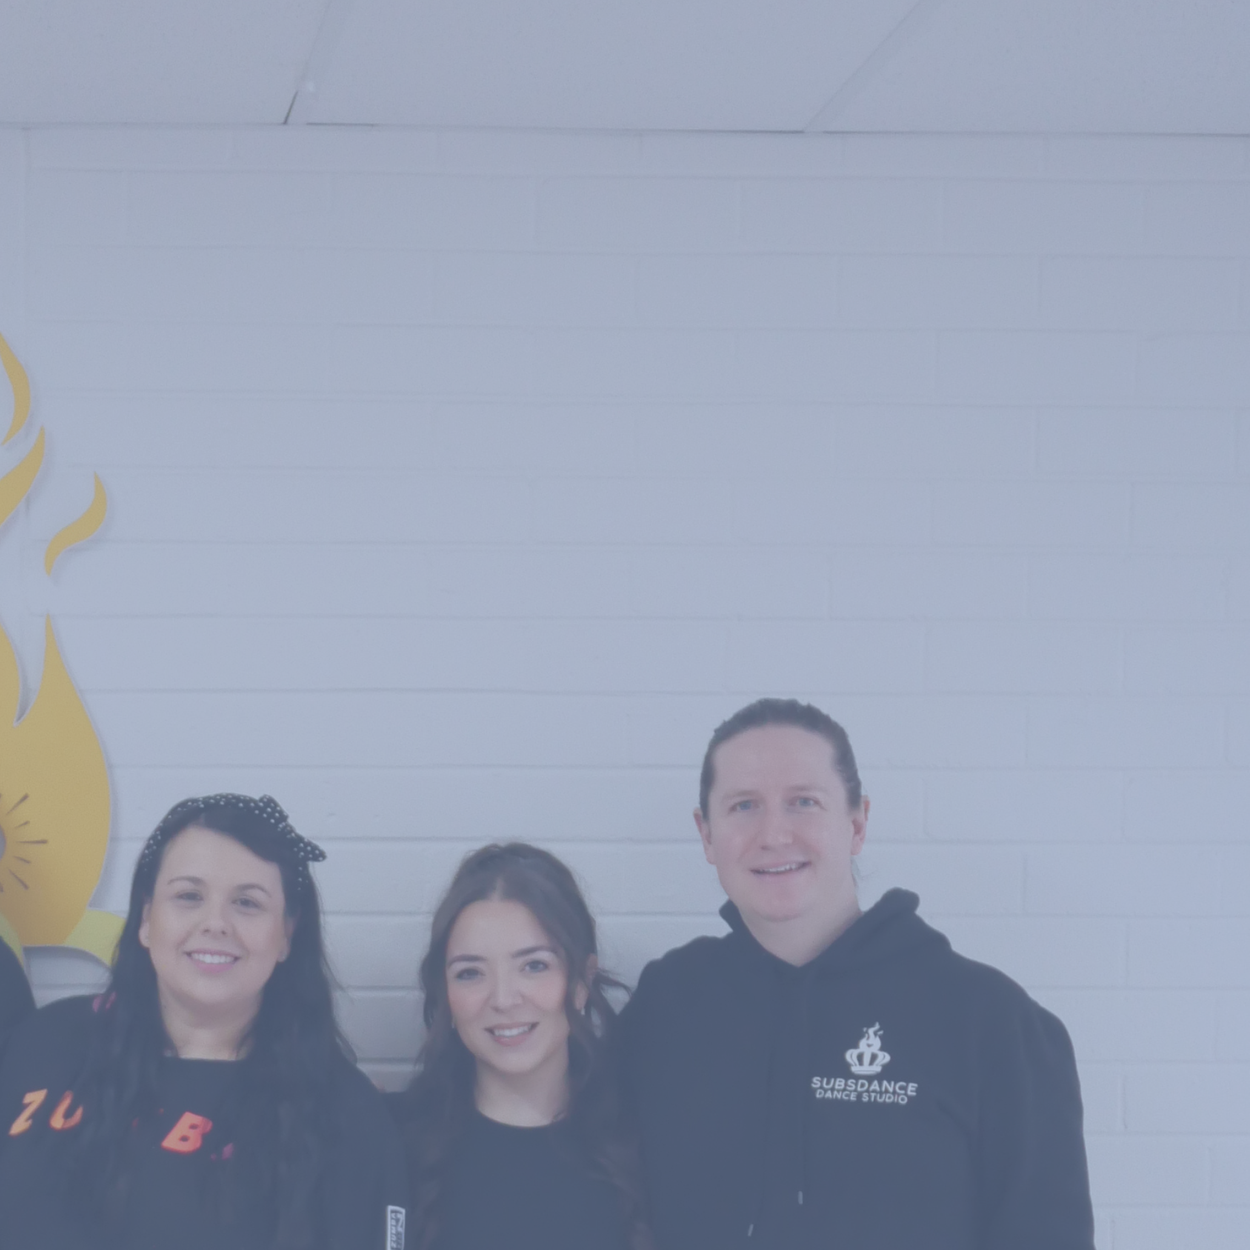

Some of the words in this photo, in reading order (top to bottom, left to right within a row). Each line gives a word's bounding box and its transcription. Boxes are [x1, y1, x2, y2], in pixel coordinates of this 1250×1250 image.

[811, 1076, 918, 1096] SUBSDANCE
[815, 1089, 857, 1101] DANCE
[862, 1092, 908, 1105] STUDIO
